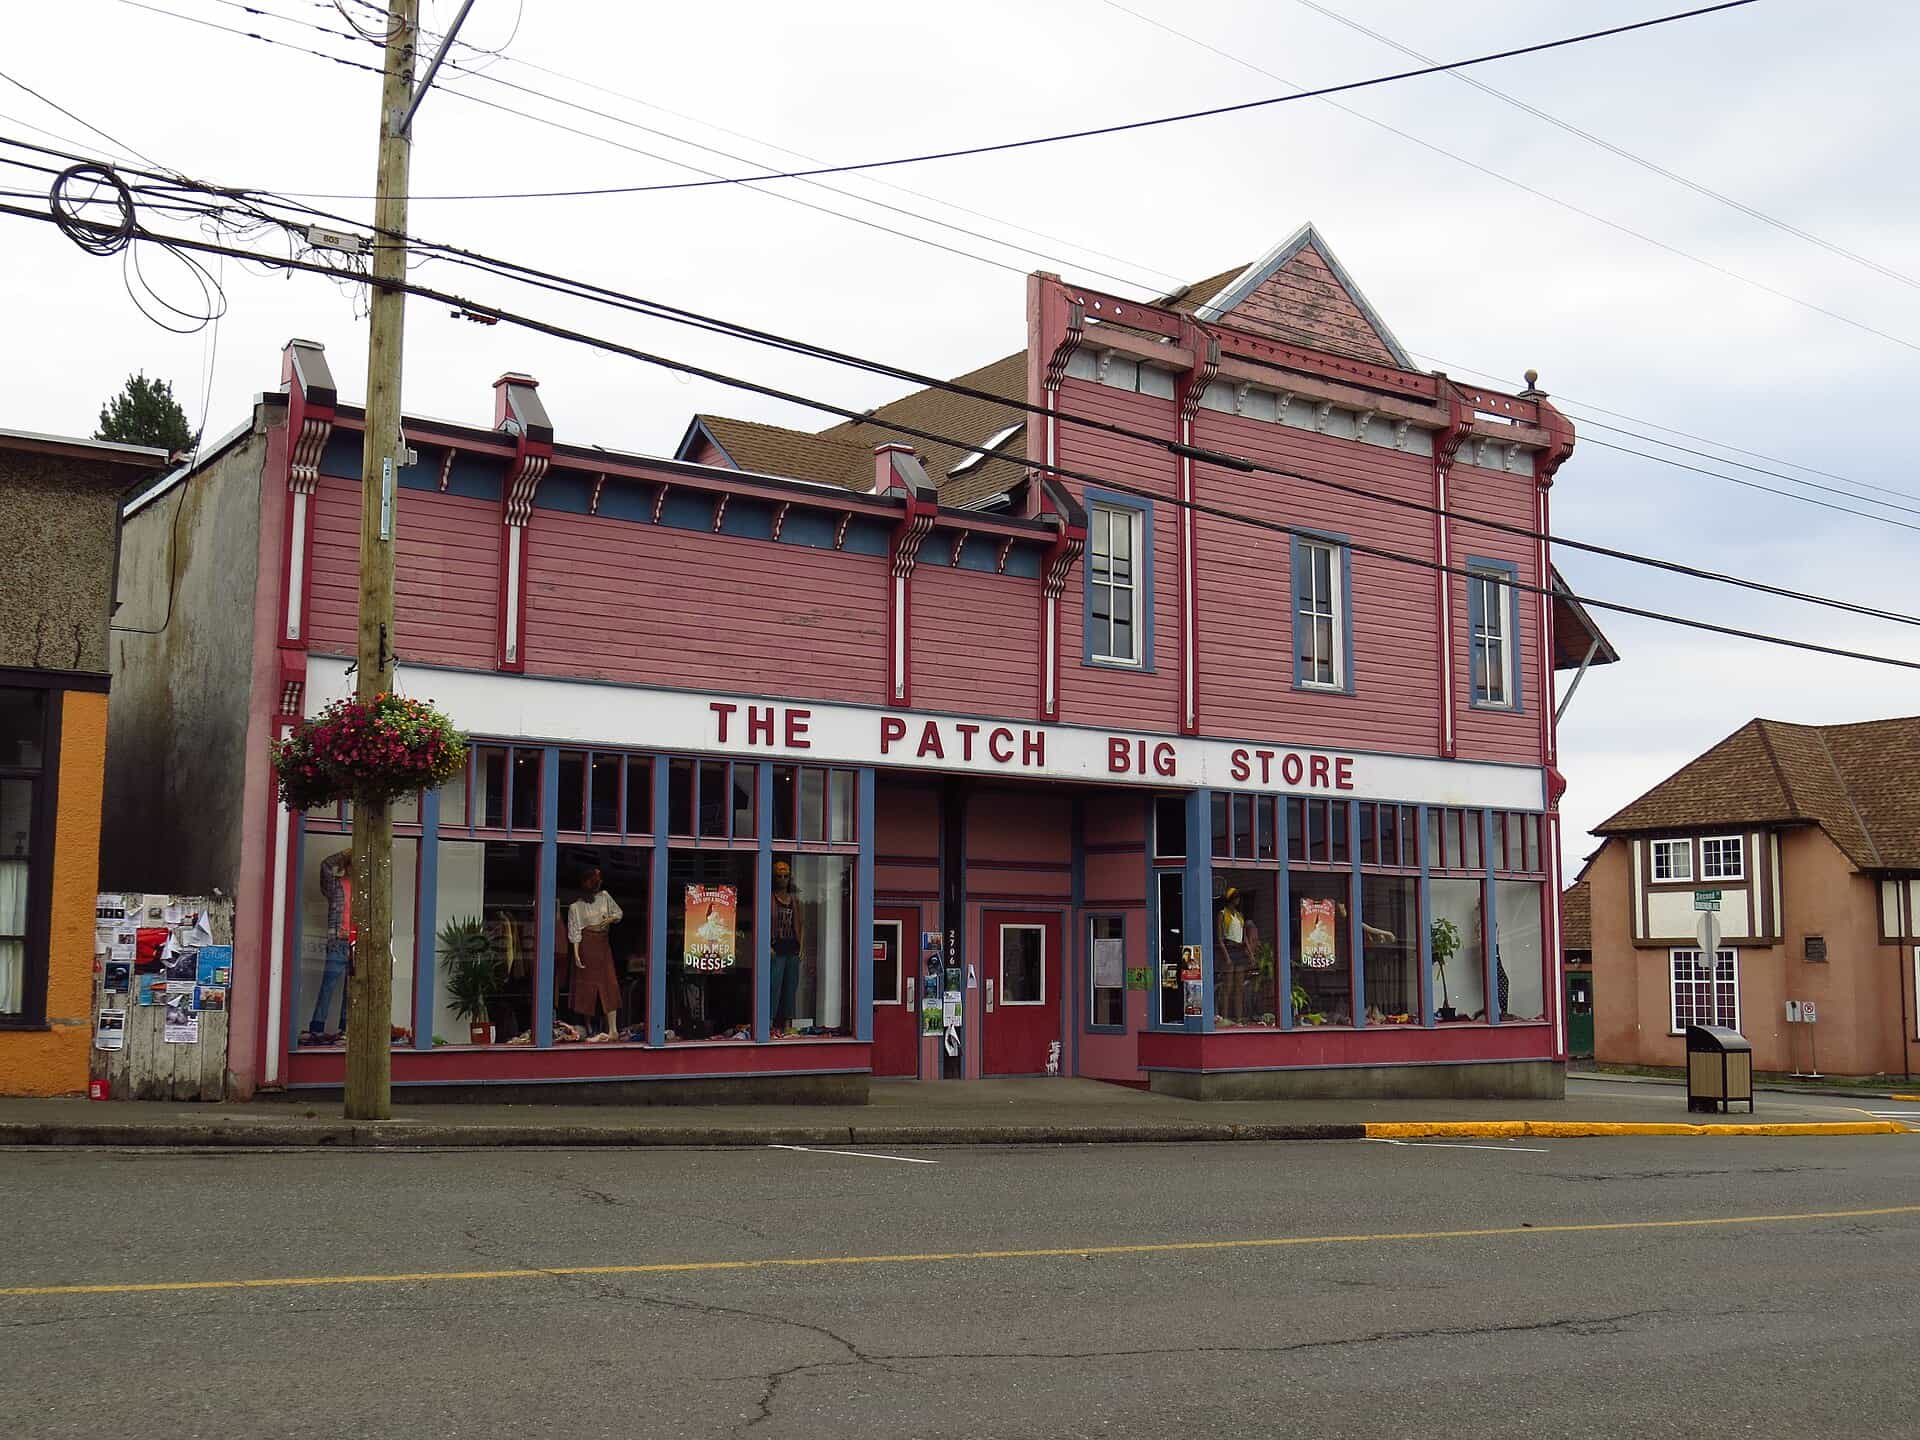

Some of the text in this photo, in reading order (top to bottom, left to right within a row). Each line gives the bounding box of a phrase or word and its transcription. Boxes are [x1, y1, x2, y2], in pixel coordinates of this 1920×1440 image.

[710, 702, 1355, 790] THE PATCH BIG STORE
[690, 943, 730, 954] SUMMER
[685, 953, 734, 970] DRESSES
[1302, 953, 1335, 968] DRESSES
